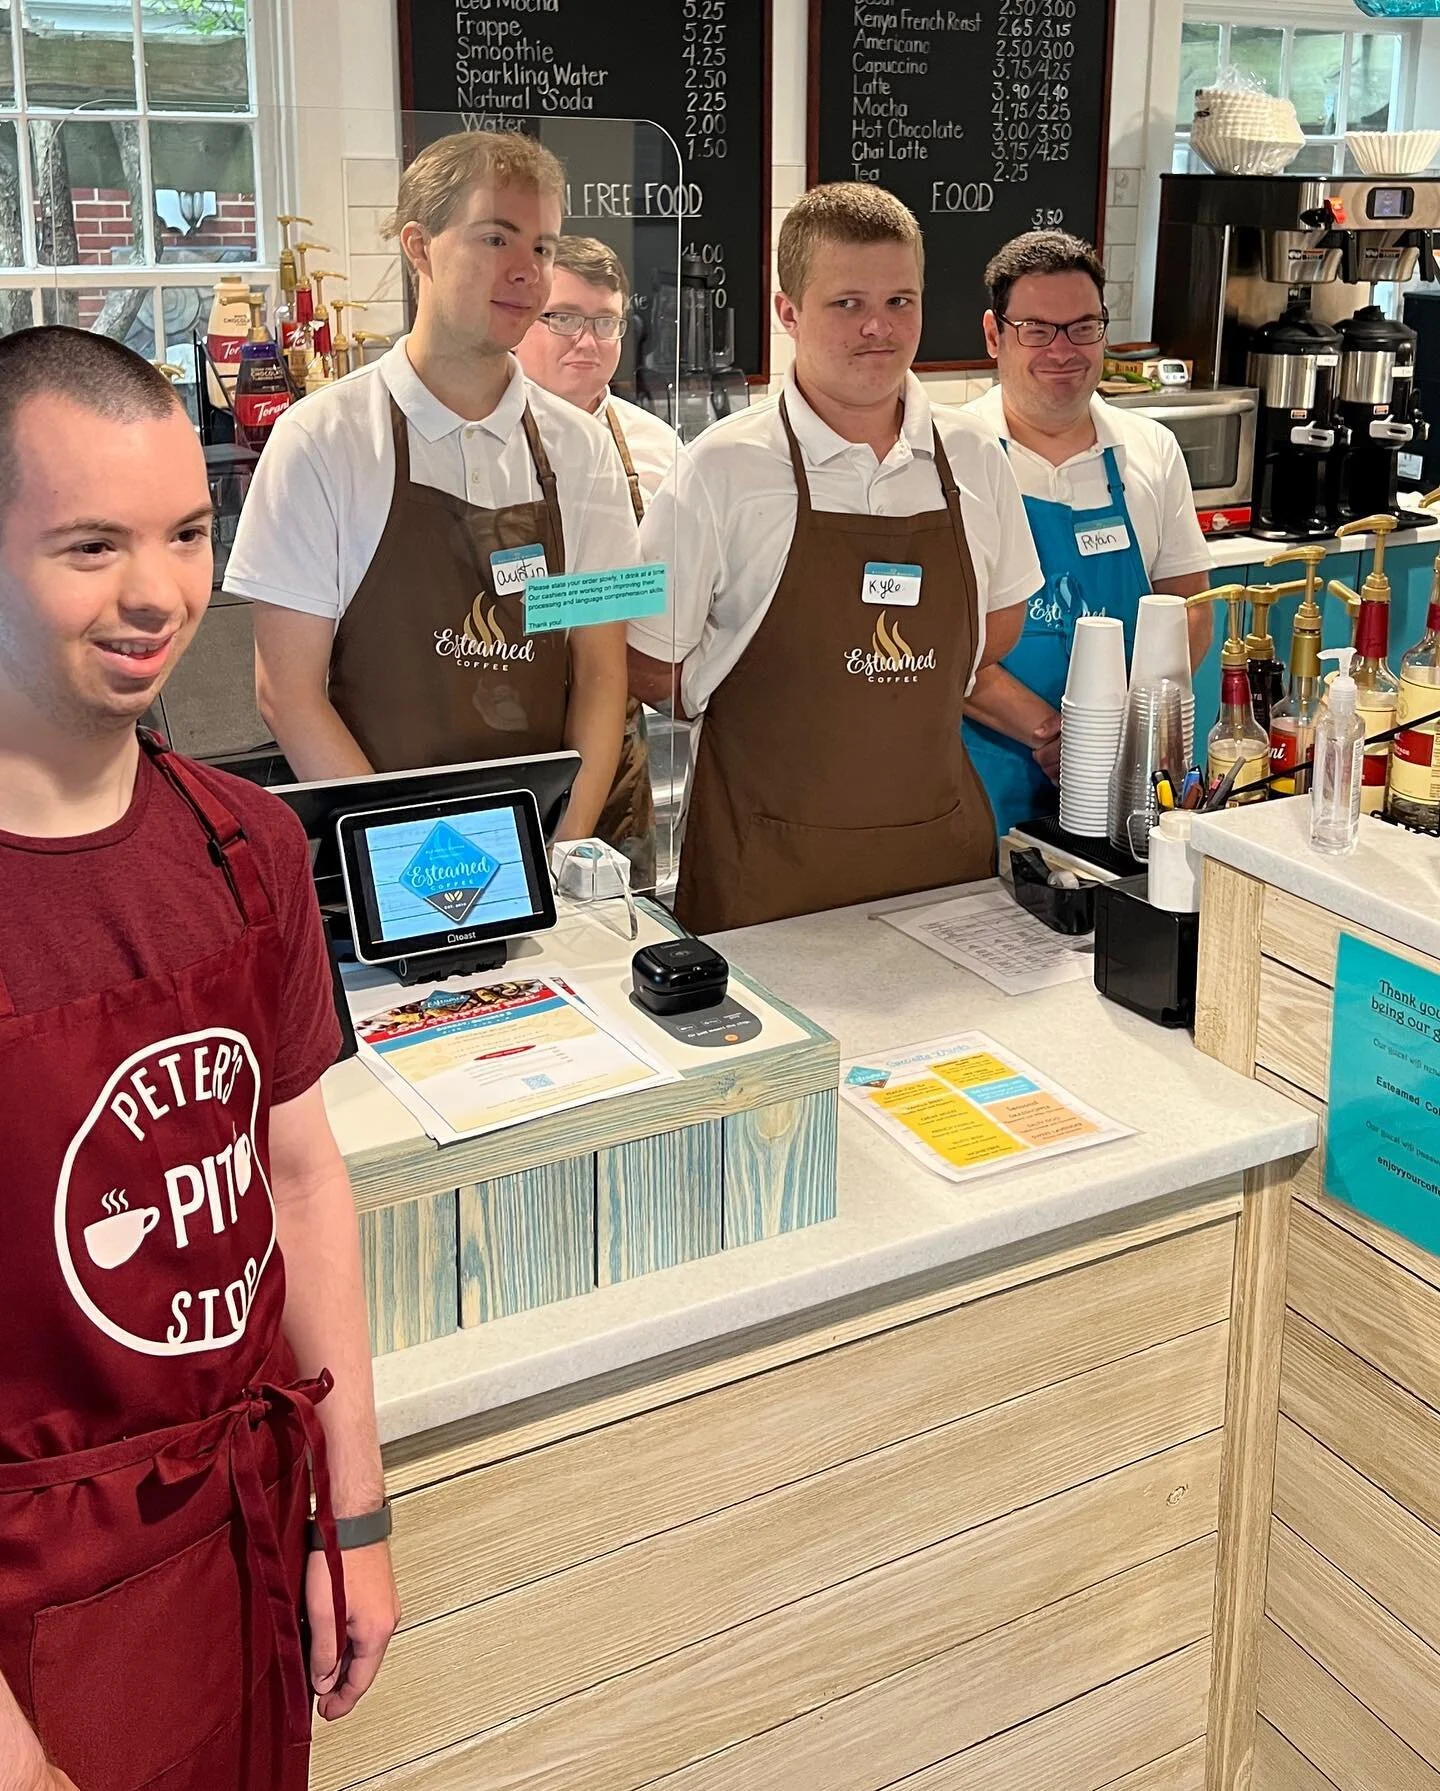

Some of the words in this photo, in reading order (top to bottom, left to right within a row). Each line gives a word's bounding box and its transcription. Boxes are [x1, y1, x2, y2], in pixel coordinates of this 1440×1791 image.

[682, 1, 725, 20] 5.25
[854, 5, 897, 36] Kenya
[901, 8, 945, 31] French
[997, 18, 1071, 37] 2.65/3.15
[456, 12, 522, 46] Frappe
[682, 24, 727, 44] 5.25
[456, 36, 554, 63] Smoothie
[682, 47, 726, 66] 4.25
[853, 28, 930, 54] Americano
[996, 39, 1075, 59] 2.50/3.00
[456, 61, 549, 94] Sparkling
[554, 63, 609, 86] Water
[684, 69, 727, 89] 2.50
[852, 52, 928, 75] Capuccino
[992, 59, 1071, 81] 3.75/4.25
[457, 87, 530, 109] Natural
[542, 88, 593, 111] Soda
[686, 92, 727, 112] 2.25
[853, 76, 891, 95] Latte
[992, 82, 1069, 102] 3.90/4.40
[852, 97, 908, 117] Mocha
[991, 102, 1071, 121] 4.75/5.25
[461, 112, 526, 133] Water
[685, 115, 727, 137] 2.00
[852, 119, 882, 139] Hot
[888, 120, 964, 139] Chocolate
[992, 123, 1072, 141] 3.00/3.50
[687, 138, 728, 160] 1.50
[852, 141, 884, 161] Chai
[889, 140, 928, 160] Latte
[991, 142, 1069, 162] 3.75/4.25
[852, 163, 880, 182] Tea
[993, 162, 1028, 182] 2.25
[584, 183, 632, 216] FREE
[645, 182, 703, 216] FOOD
[933, 182, 994, 210] FOOD
[1031, 208, 1064, 226] 3.50
[682, 242, 724, 264] 400
[221, 340, 241, 359] Tor
[1081, 534, 1117, 550] Ryan
[541, 592, 567, 600] cashiers
[579, 586, 603, 594] working
[612, 581, 641, 590] improving
[567, 580, 581, 588] your
[869, 580, 901, 599] Kyle
[528, 601, 562, 611] processing
[563, 598, 575, 606] and
[575, 596, 603, 605] language
[604, 590, 649, 601] comprehension
[528, 621, 548, 629] Thank
[433, 628, 536, 662] Esteamed
[456, 659, 509, 671] COFFEE
[844, 648, 937, 676] Esteamed
[868, 675, 919, 683] COFFEE
[407, 856, 490, 888] Esteamed
[430, 879, 475, 891] COFFEE
[455, 931, 477, 942] toast
[1379, 979, 1417, 1008] Thank
[1371, 995, 1405, 1025] being
[1407, 1016, 1431, 1034] our
[1373, 1038, 1387, 1050] Our
[111, 1044, 243, 1141] PETER'S
[1376, 1075, 1420, 1106] Esteamed
[1366, 1120, 1379, 1133] Our
[164, 1143, 238, 1249] PIT
[166, 1257, 258, 1345] STOP
